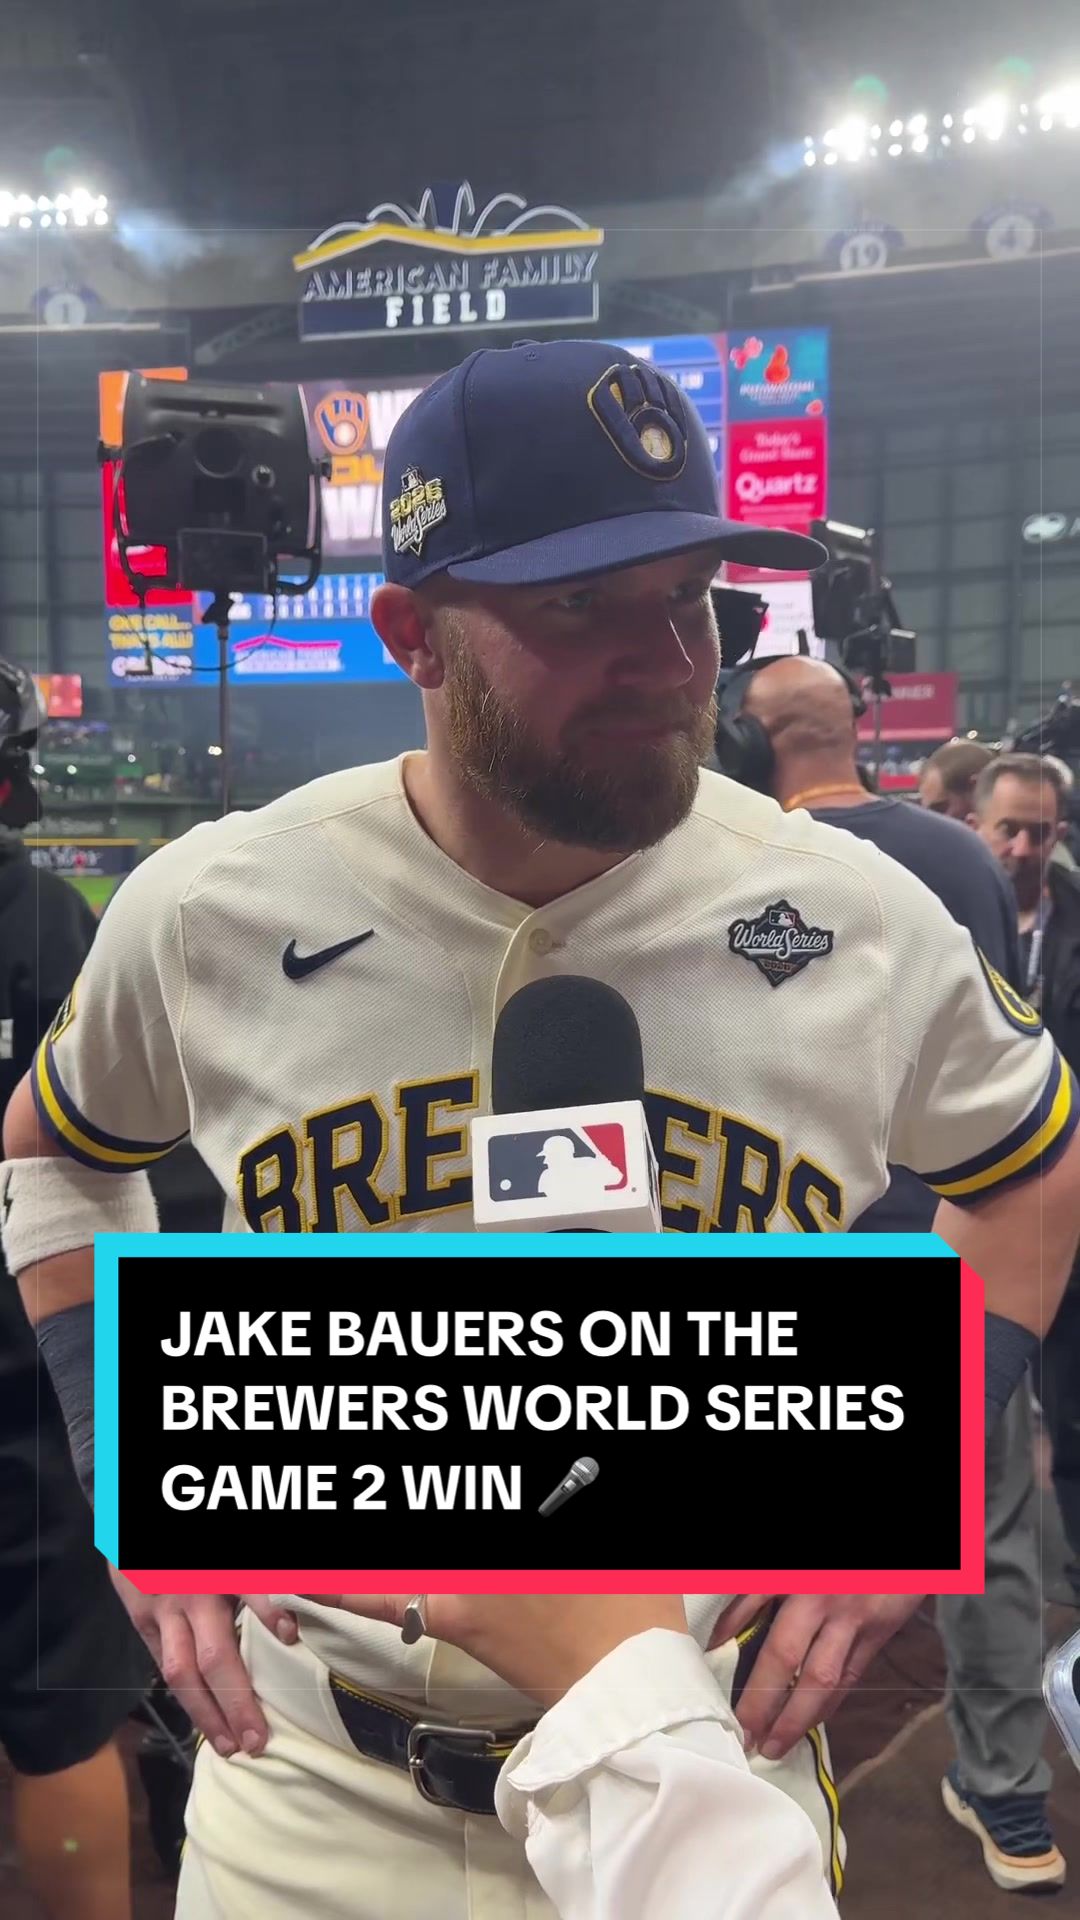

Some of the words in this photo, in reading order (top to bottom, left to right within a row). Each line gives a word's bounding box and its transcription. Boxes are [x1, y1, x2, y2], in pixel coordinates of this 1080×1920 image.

[300, 259, 469, 303] AMERICAN
[479, 251, 598, 290] FAMILY
[386, 289, 506, 328] FIELD
[735, 472, 819, 503] Quartz
